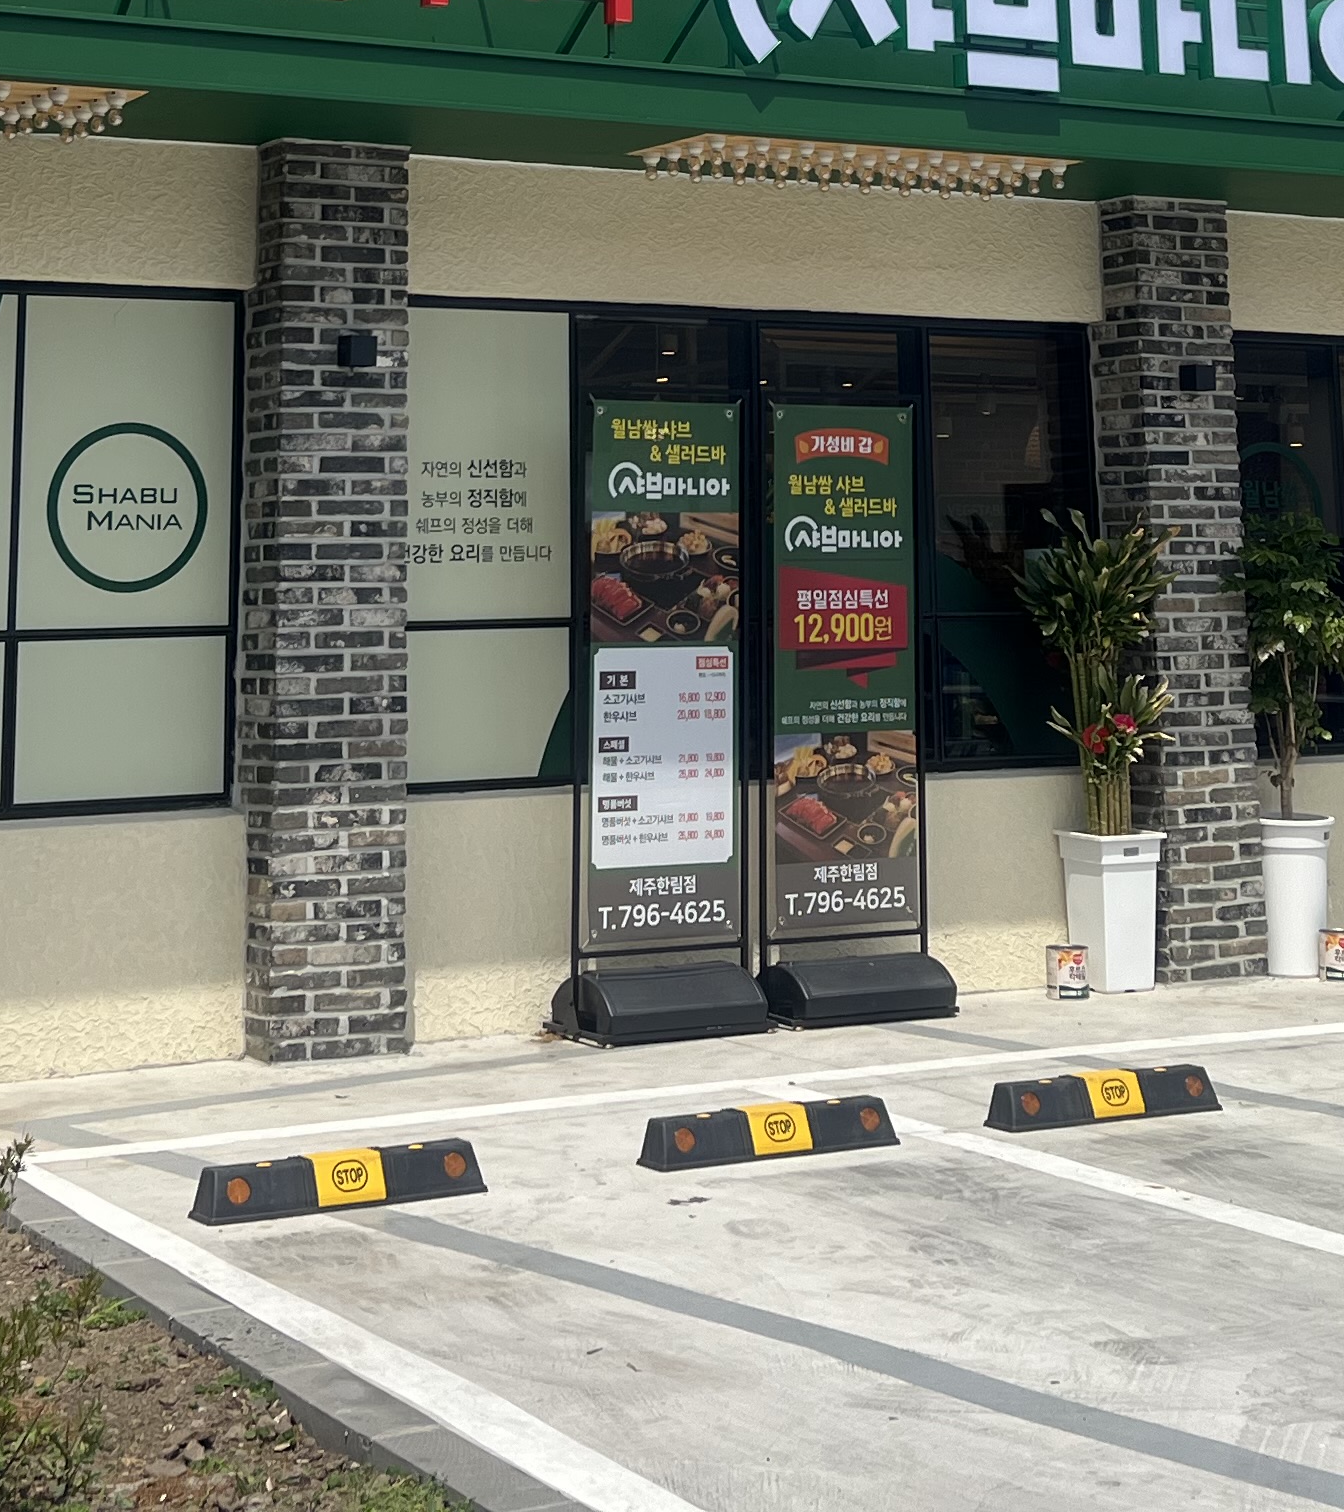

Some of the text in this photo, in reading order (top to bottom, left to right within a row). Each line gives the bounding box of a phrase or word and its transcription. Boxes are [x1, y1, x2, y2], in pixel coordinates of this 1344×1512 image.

[611, 418, 692, 440] 월남쌈 샤브
[650, 443, 727, 465] & 샐러드바
[810, 434, 874, 454] 가성비 갑
[421, 459, 527, 478] 자연의 신선함과
[72, 484, 177, 504] SHABU
[616, 469, 730, 500] 샤브마니아
[788, 474, 865, 495] 월남쌈 샤브
[421, 488, 527, 508] 농부의 정직함에
[824, 497, 897, 518] & 샐러드바
[87, 510, 182, 530] MANIA
[461, 517, 501, 535] 정성을
[507, 517, 533, 534] 더해
[792, 522, 903, 553] 샤브마니아
[449, 544, 494, 563] 요리를
[500, 545, 552, 562] 만듭니다
[796, 589, 889, 610] 평일점심특선
[793, 613, 892, 644] 12,900원
[813, 863, 878, 883] 제주한림점
[629, 875, 696, 897] 제주한림점
[785, 887, 906, 916] T.796-4625
[598, 900, 726, 930] T.796-4625
[1104, 1085, 1126, 1101] STOP
[768, 1119, 791, 1136] STOP
[336, 1167, 363, 1185] STOP
